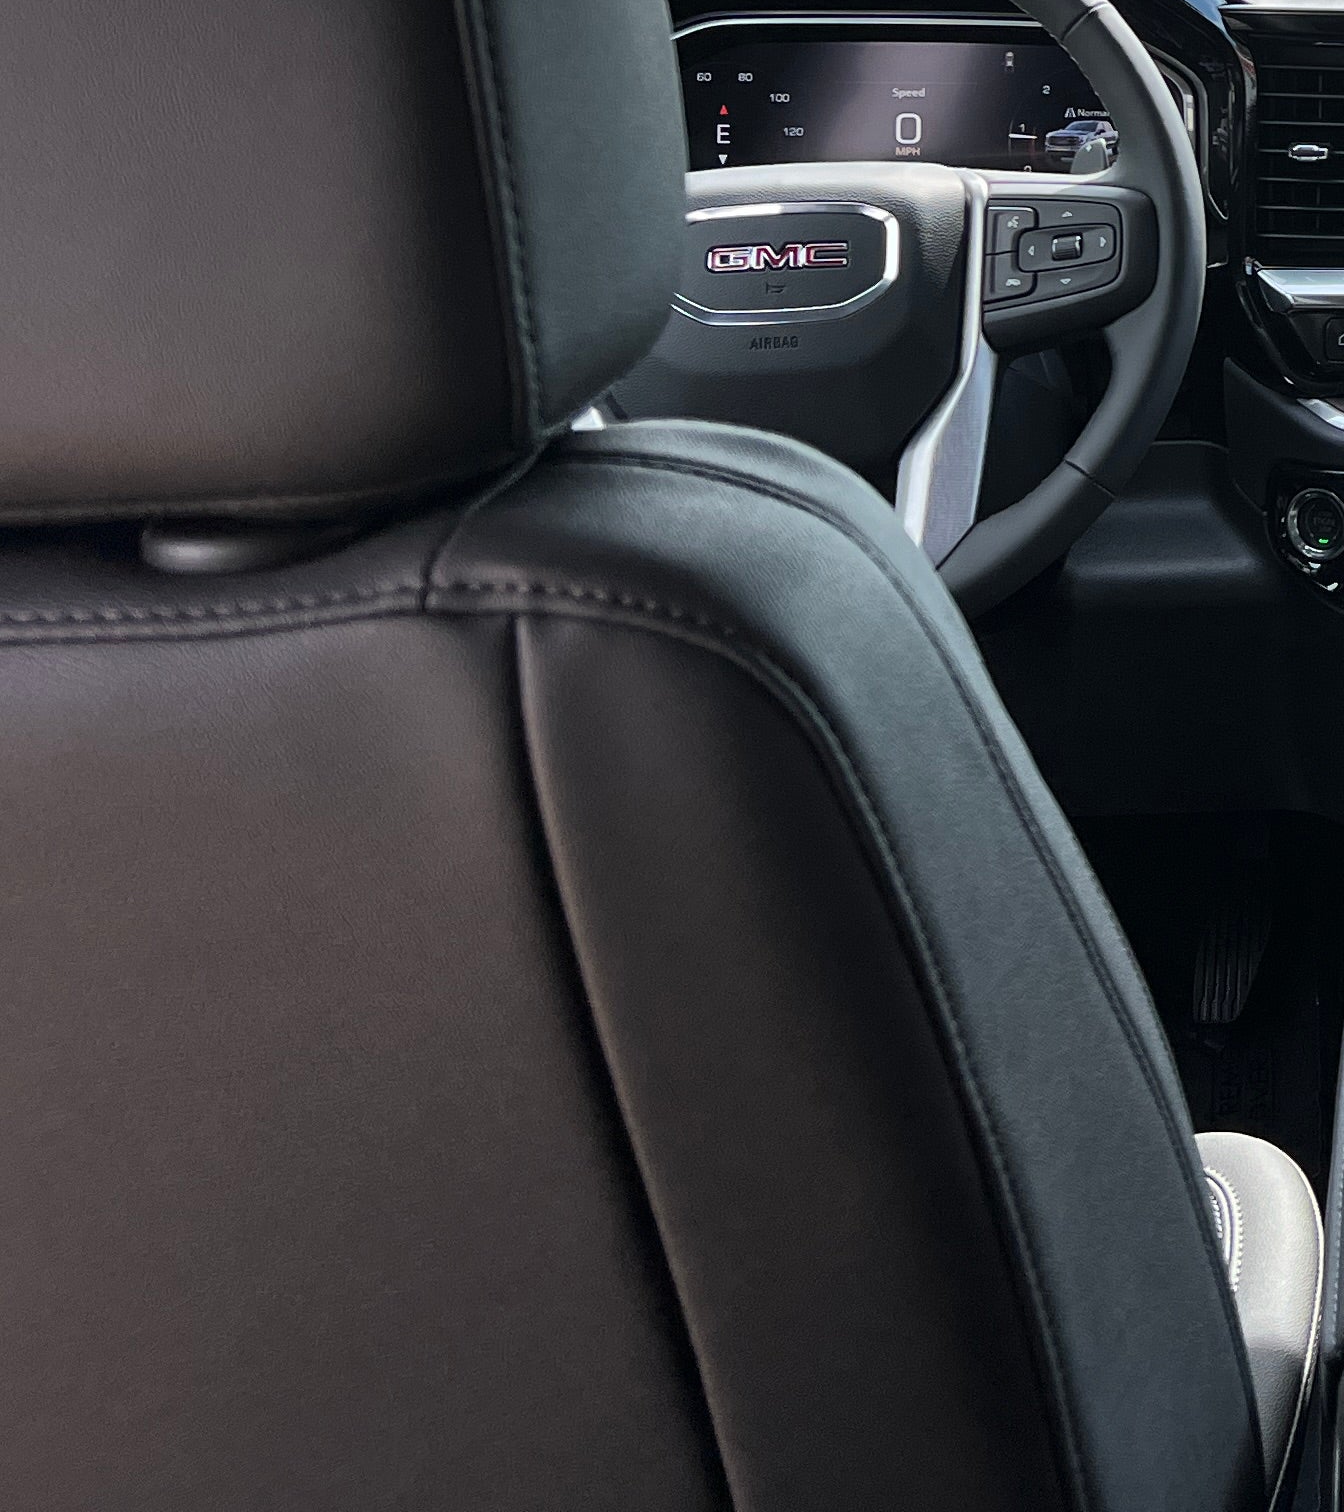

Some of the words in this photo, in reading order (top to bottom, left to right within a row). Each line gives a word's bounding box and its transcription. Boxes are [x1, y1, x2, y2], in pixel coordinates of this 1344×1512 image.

[696, 72, 712, 82] 60
[738, 72, 753, 82] 80
[892, 88, 926, 99] Speed
[1042, 85, 1051, 95] 2
[769, 93, 790, 103] 100
[783, 127, 804, 137] 120
[895, 112, 922, 145] 0
[717, 124, 730, 144] E
[895, 146, 921, 156] MPH
[707, 242, 848, 272] GMC
[750, 337, 799, 350] AIRBAG
